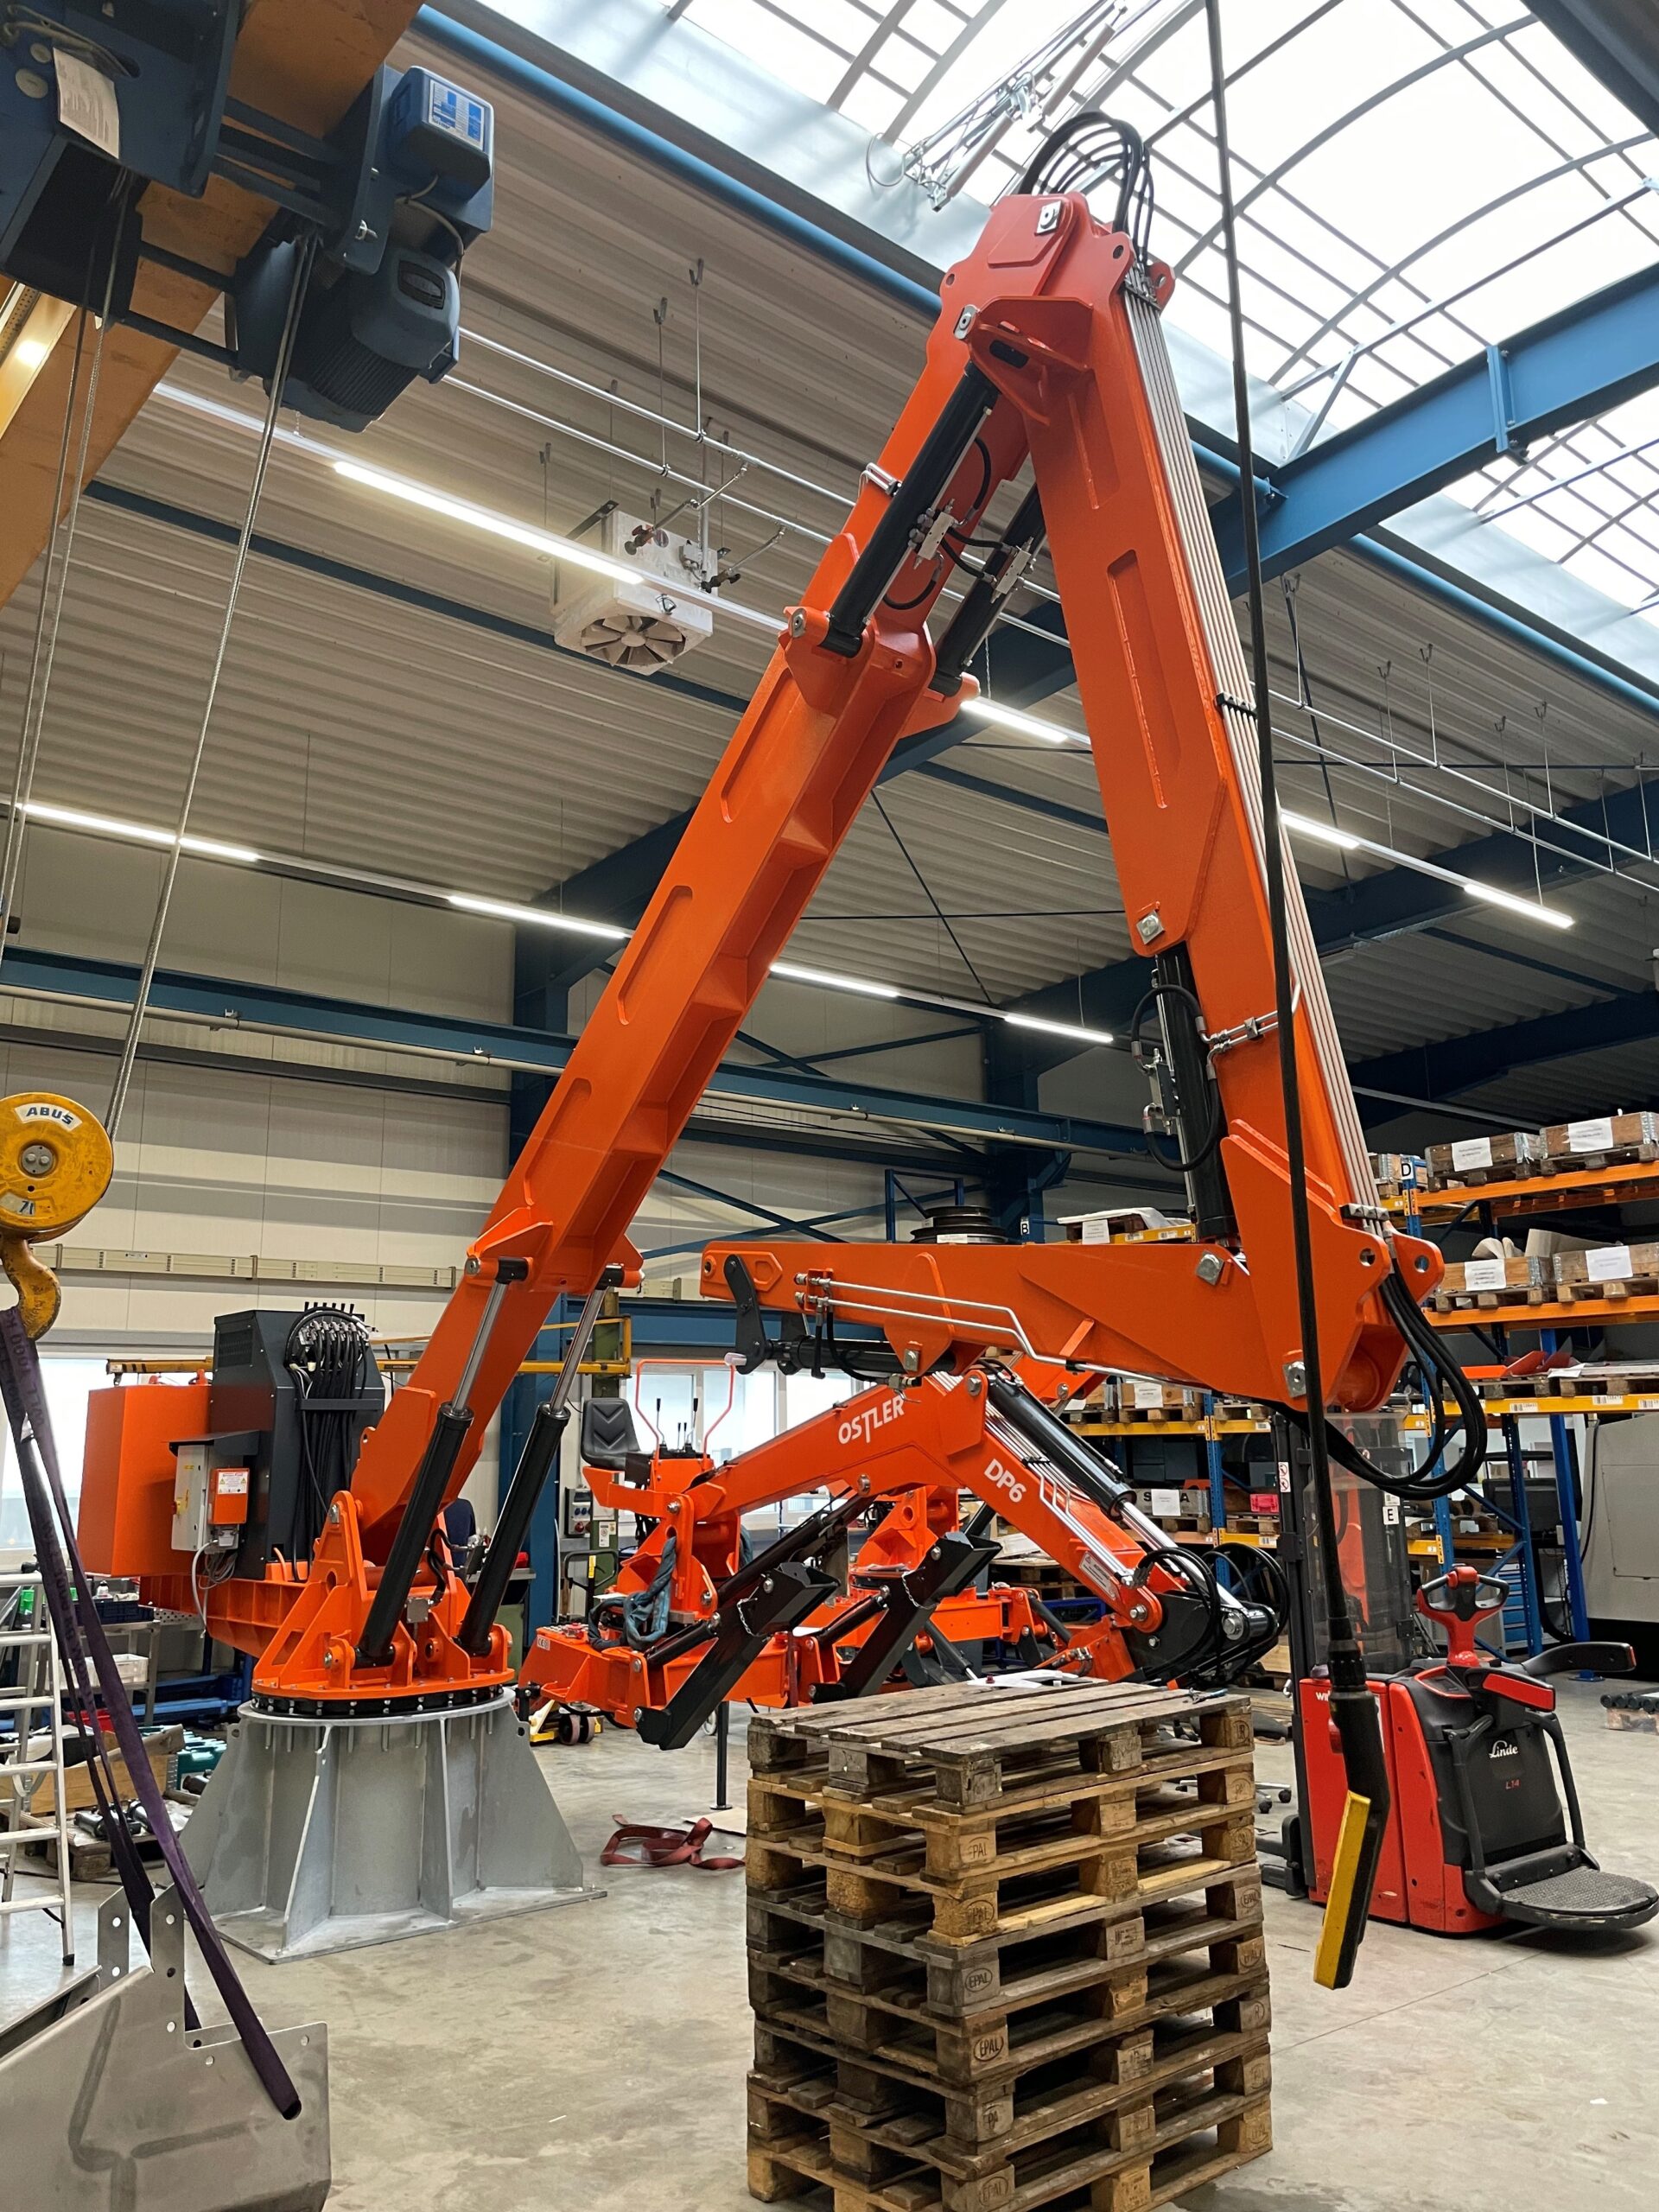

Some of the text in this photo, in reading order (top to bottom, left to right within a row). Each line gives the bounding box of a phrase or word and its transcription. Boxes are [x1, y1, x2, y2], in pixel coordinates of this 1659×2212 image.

[26, 1106, 74, 1125] ABUS
[1402, 1163, 1412, 1176] D
[1022, 1223, 1029, 1235] B
[838, 1395, 905, 1445] OSTLER
[983, 1458, 1027, 1503] DP6
[1387, 1508, 1395, 1522] E
[1488, 1739, 1519, 1758] Linde
[969, 1972, 989, 1988] EPAL
[979, 2038, 1000, 2057] EPAL
